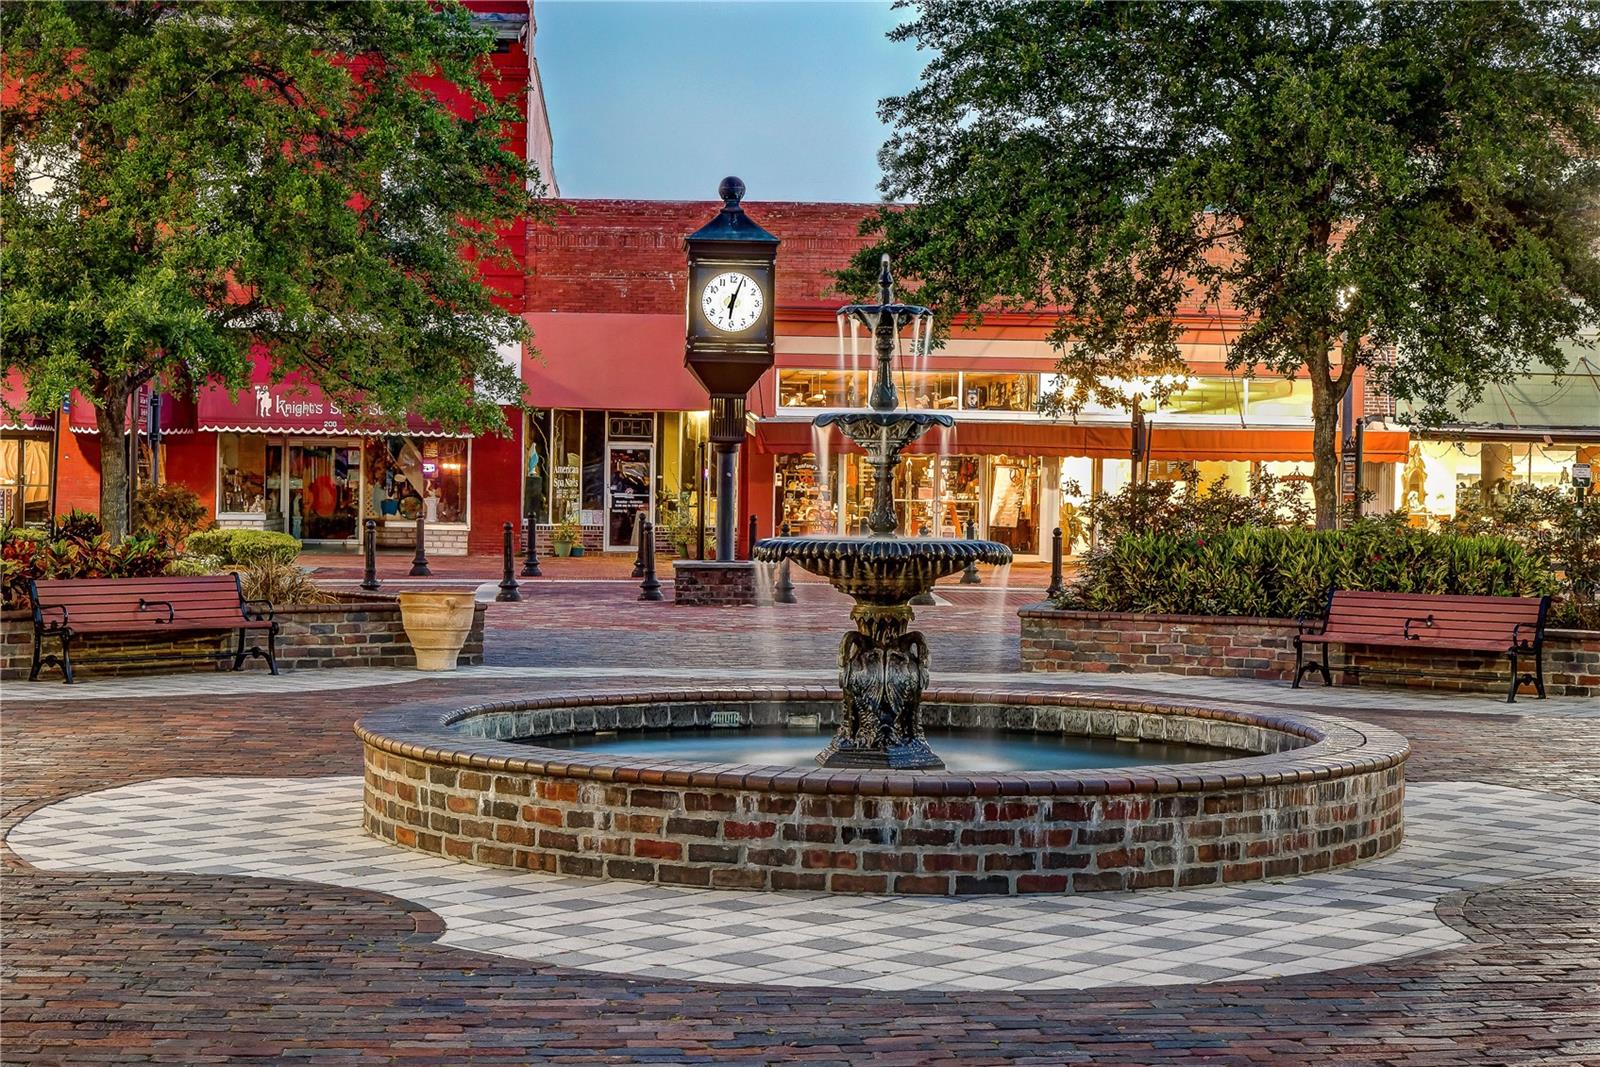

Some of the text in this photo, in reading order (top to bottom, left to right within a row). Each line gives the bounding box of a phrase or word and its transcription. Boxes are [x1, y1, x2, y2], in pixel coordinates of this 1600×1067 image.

[730, 275, 738, 283] 12
[710, 285, 719, 294] 10
[750, 288, 756, 296] 2
[706, 297, 712, 305] 9
[754, 299, 760, 308] 3
[718, 316, 724, 325] 7
[276, 394, 323, 417] Knight's
[611, 420, 652, 435] OPEN
[553, 464, 579, 473] American
[553, 477, 564, 488] Spa
